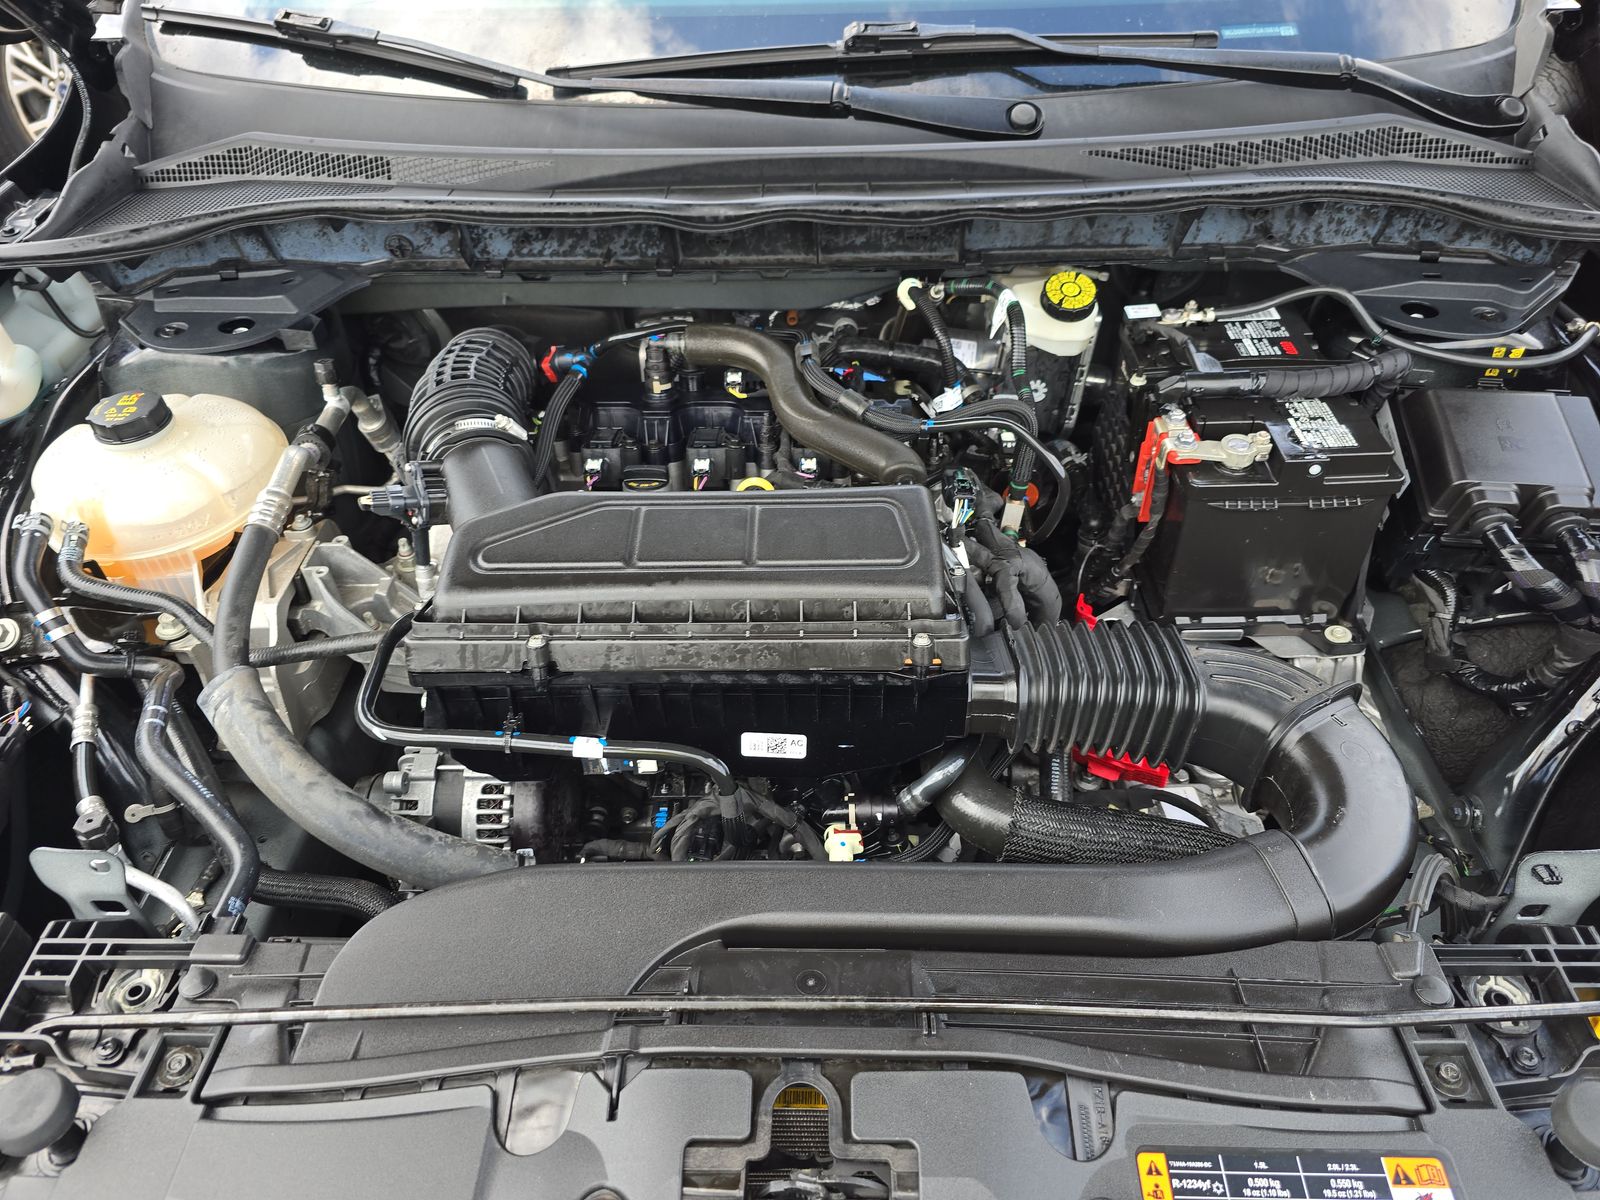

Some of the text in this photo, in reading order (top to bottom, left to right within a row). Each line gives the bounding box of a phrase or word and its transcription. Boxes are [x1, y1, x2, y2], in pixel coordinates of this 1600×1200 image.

[1171, 1178, 1212, 1191] R-1234yf
[1247, 1177, 1281, 1190] 0.500 kg
[1329, 1178, 1365, 1190] 0.550 kg
[1251, 1189, 1261, 1197] oz
[1337, 1190, 1347, 1198] oz
